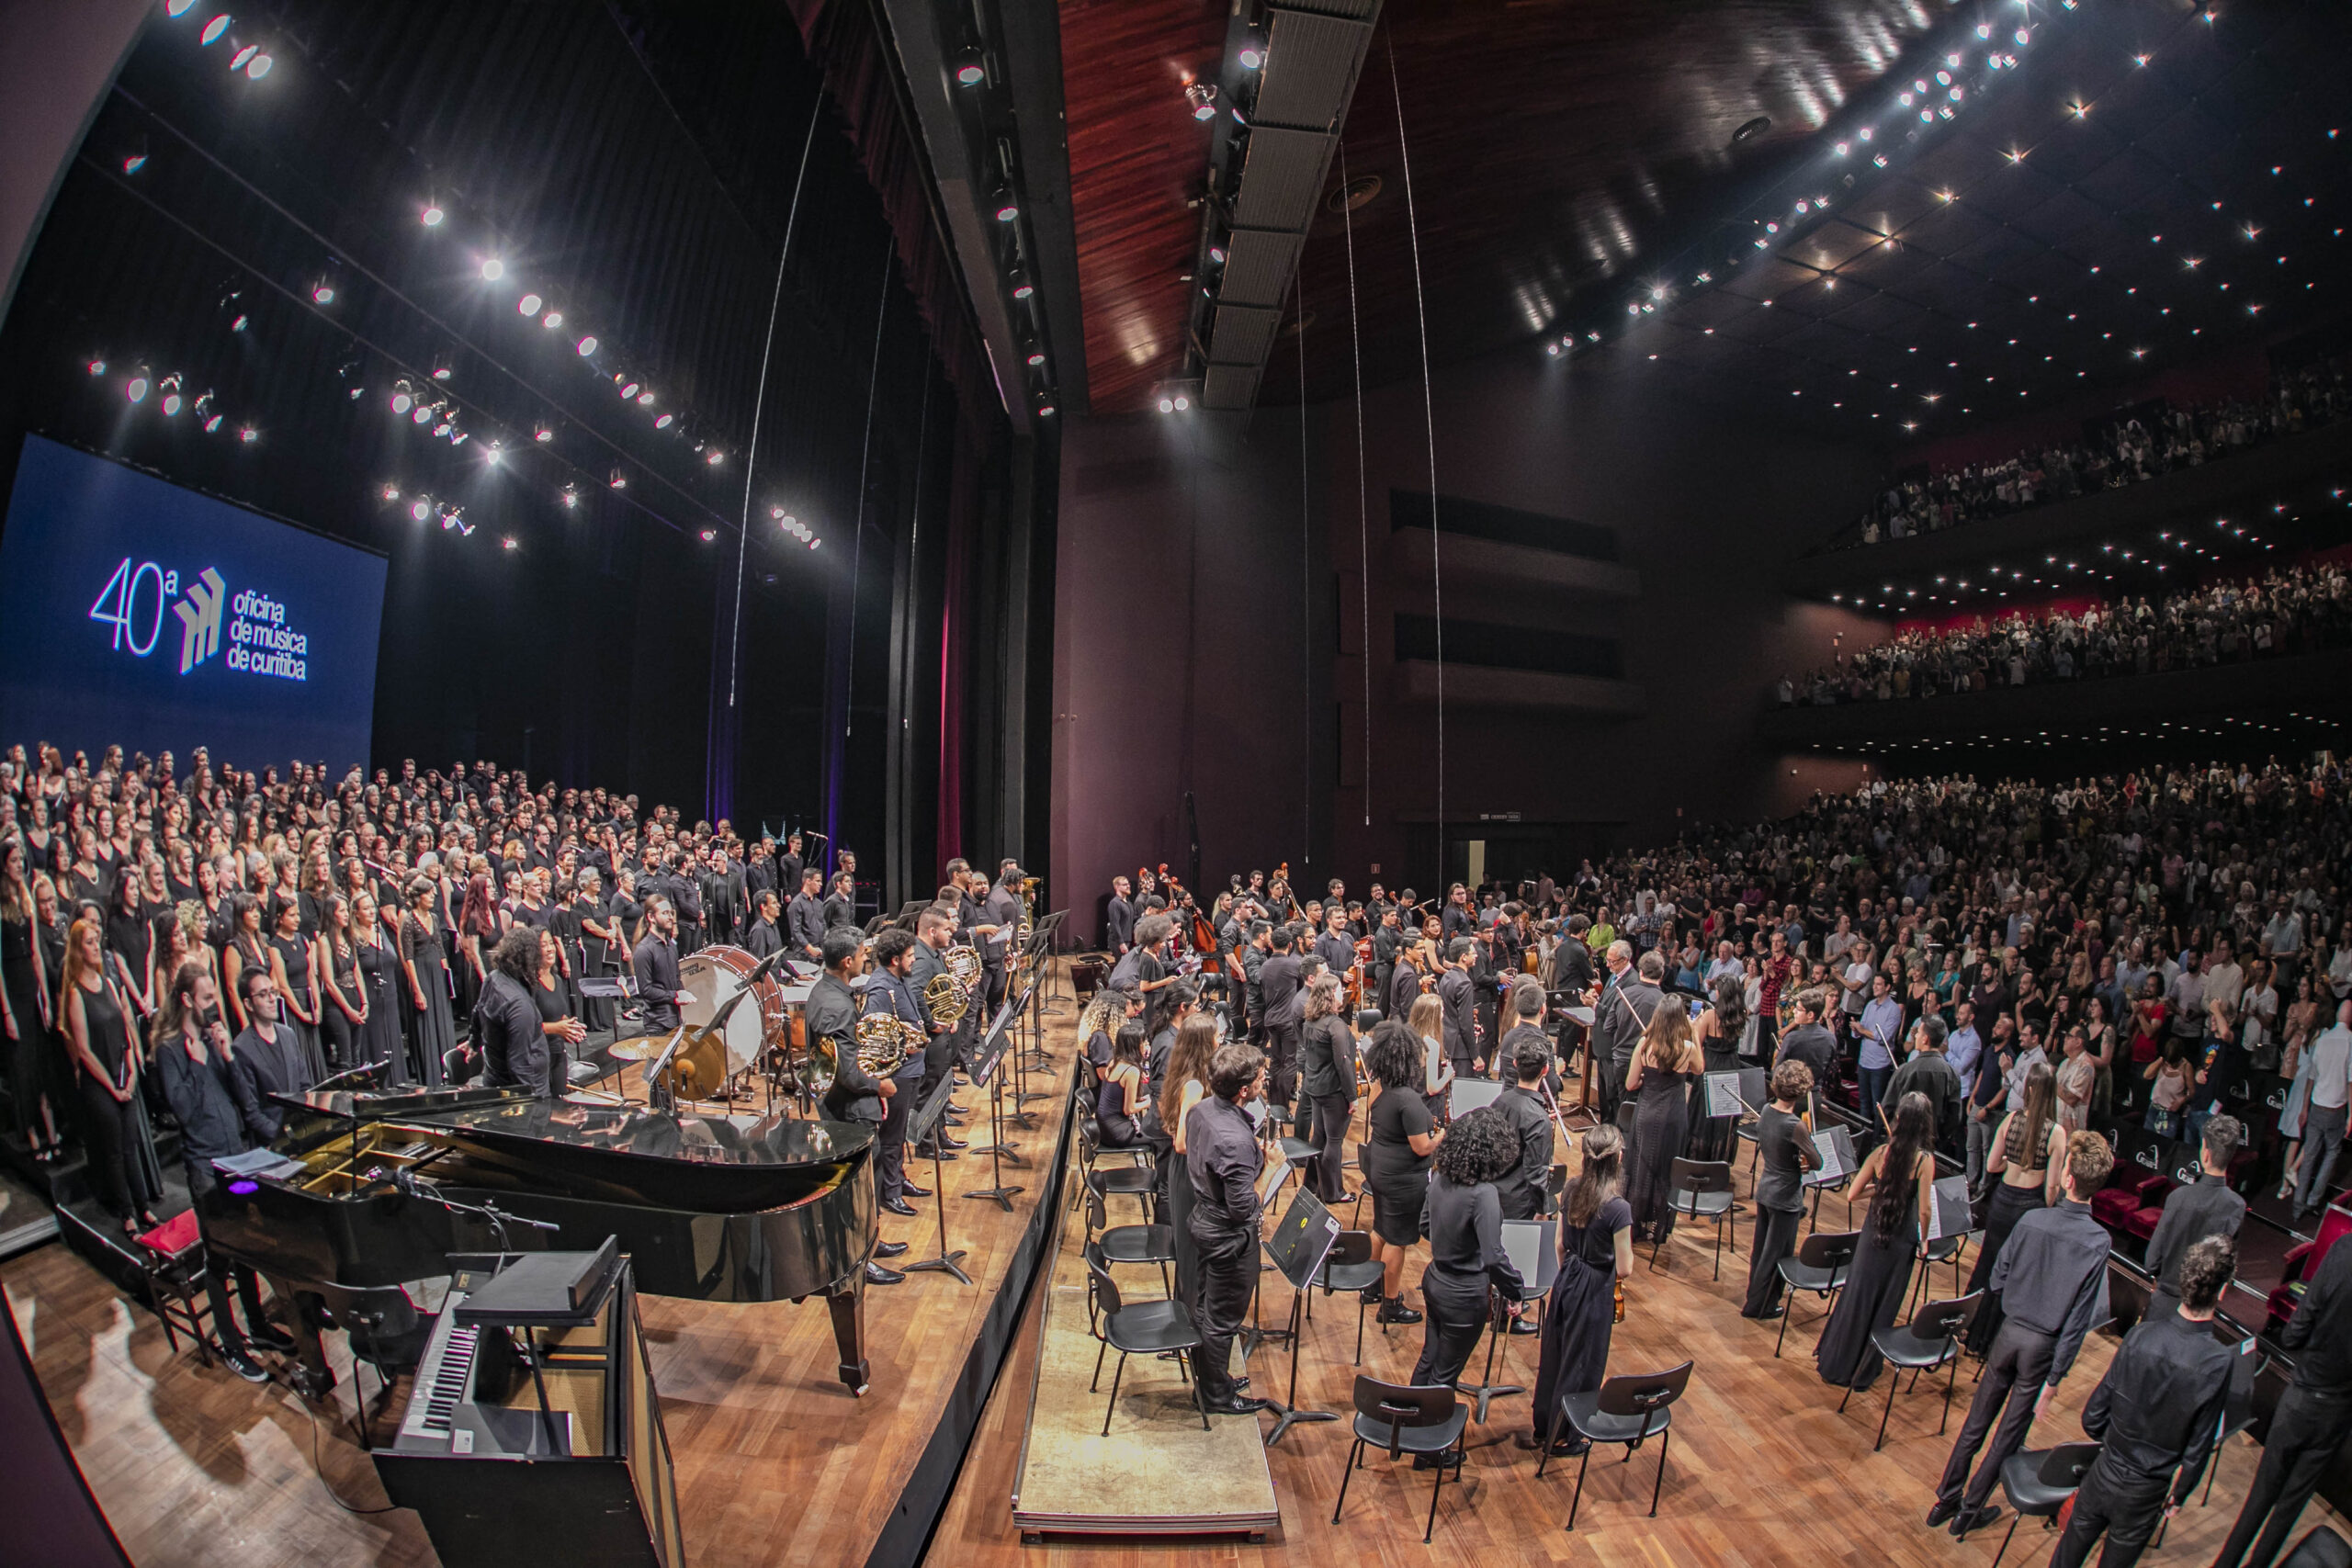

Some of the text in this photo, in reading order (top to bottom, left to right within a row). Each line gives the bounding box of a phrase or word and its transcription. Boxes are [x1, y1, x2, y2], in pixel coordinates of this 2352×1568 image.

[232, 589, 286, 624] oficina
[231, 615, 308, 656] de música
[227, 642, 307, 681] de curitiba
